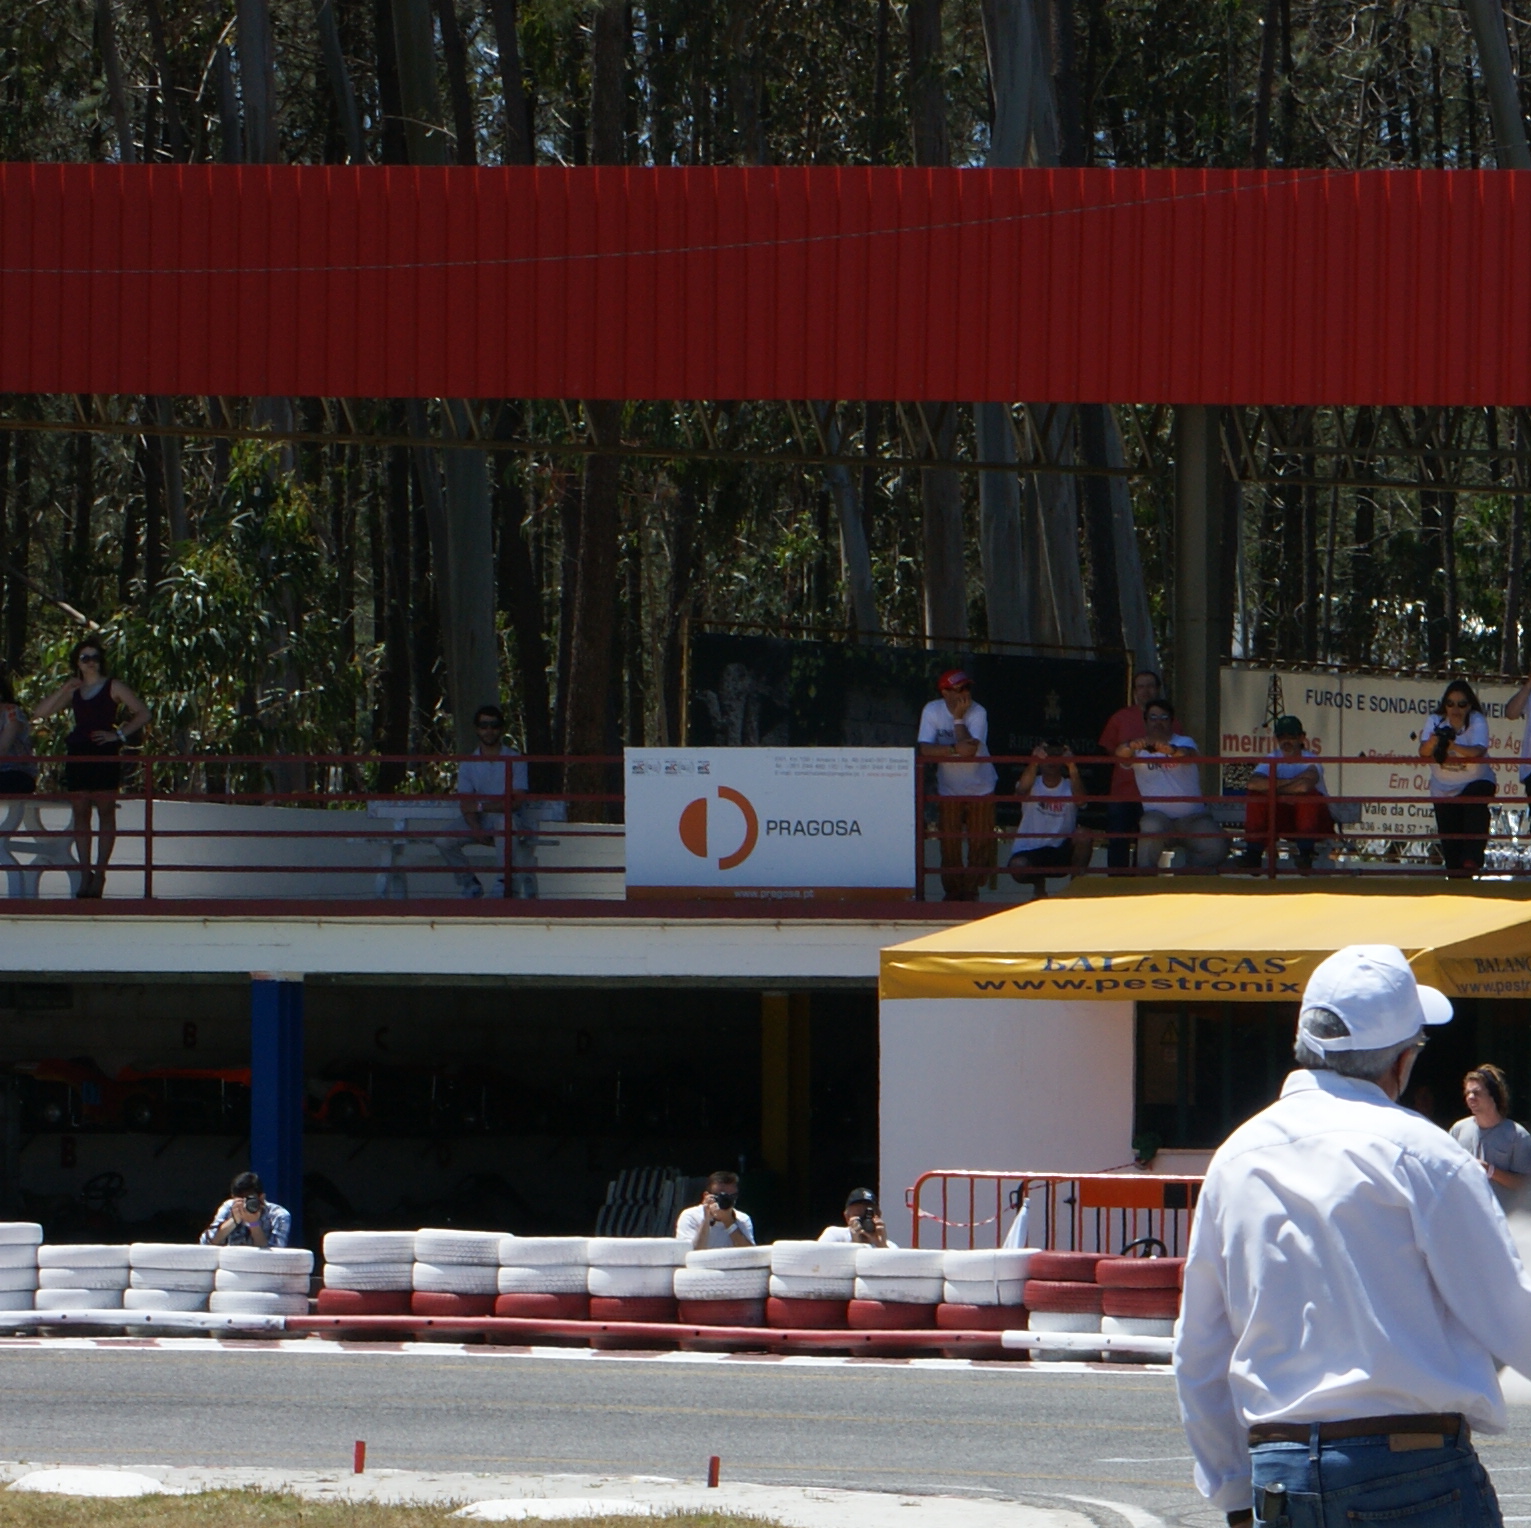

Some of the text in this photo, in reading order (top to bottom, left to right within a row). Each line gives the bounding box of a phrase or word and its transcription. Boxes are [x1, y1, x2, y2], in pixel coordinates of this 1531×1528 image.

[1306, 689, 1353, 709] FUROS
[1357, 694, 1365, 710] E
[1389, 773, 1409, 790] Em
[1363, 803, 1435, 818] Vale da Cruz
[766, 820, 862, 836] PRAGOSA
[734, 889, 816, 900] www.pragosa.pt
